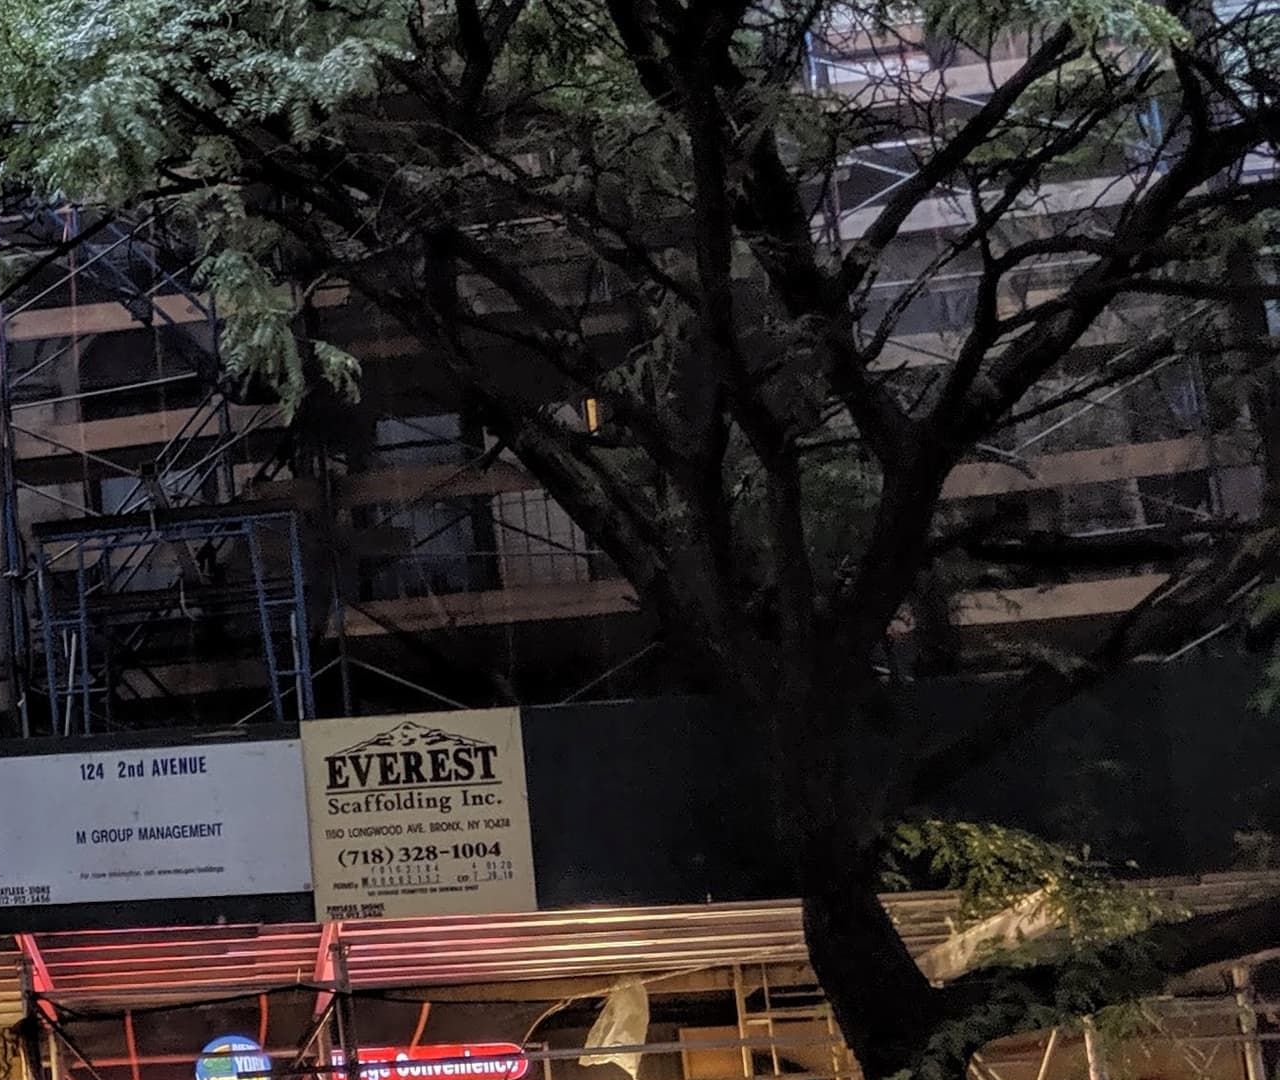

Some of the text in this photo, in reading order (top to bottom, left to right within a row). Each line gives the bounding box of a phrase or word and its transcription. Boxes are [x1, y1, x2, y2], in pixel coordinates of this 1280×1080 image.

[79, 756, 207, 781] 124 2nd AVENUE
[324, 745, 498, 790] EVEREST
[327, 789, 502, 816] Scaffolding Inc.
[76, 823, 223, 845] M GROUP MANAGEMENT
[337, 841, 502, 868] (718) 328-1004
